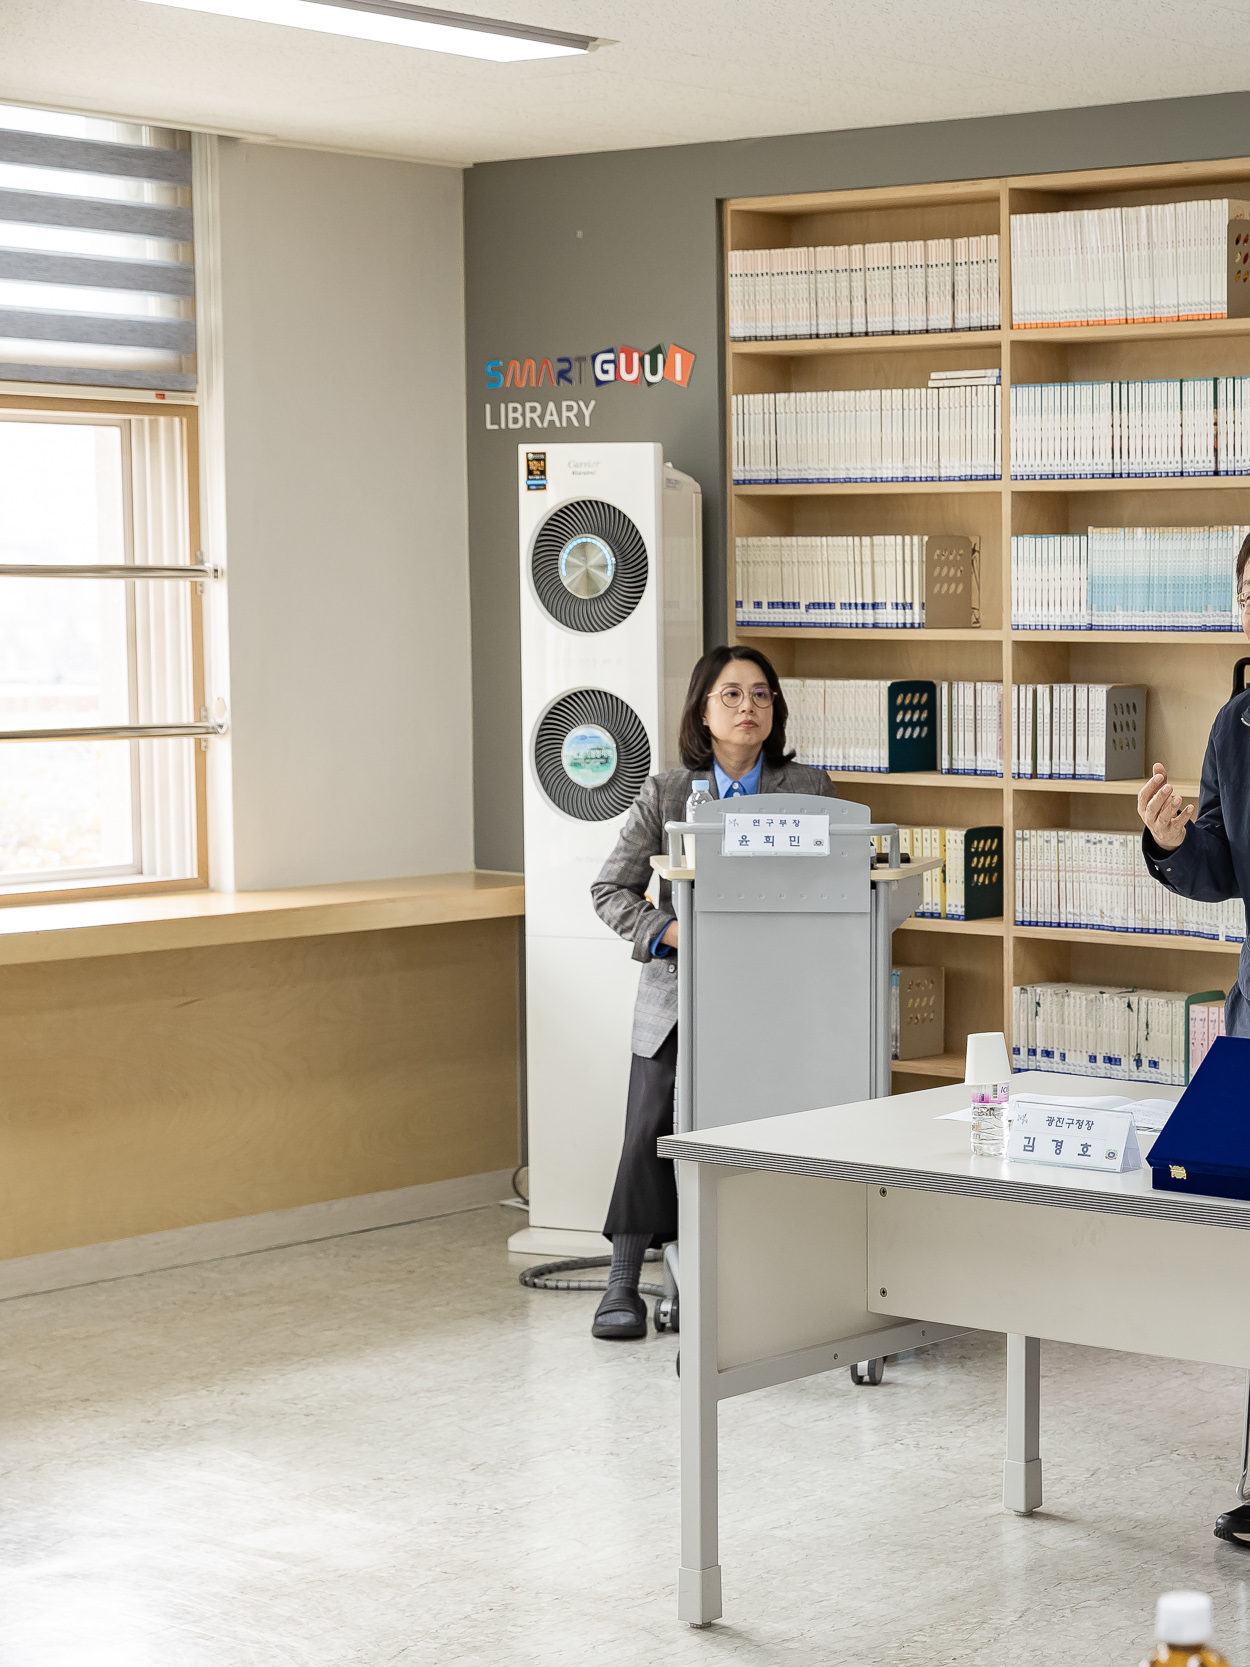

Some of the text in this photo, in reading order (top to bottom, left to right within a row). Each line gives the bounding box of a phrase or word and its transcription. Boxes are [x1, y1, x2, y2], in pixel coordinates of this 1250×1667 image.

[485, 351, 683, 388] SMART GUUI
[485, 400, 596, 430] LIBRARY
